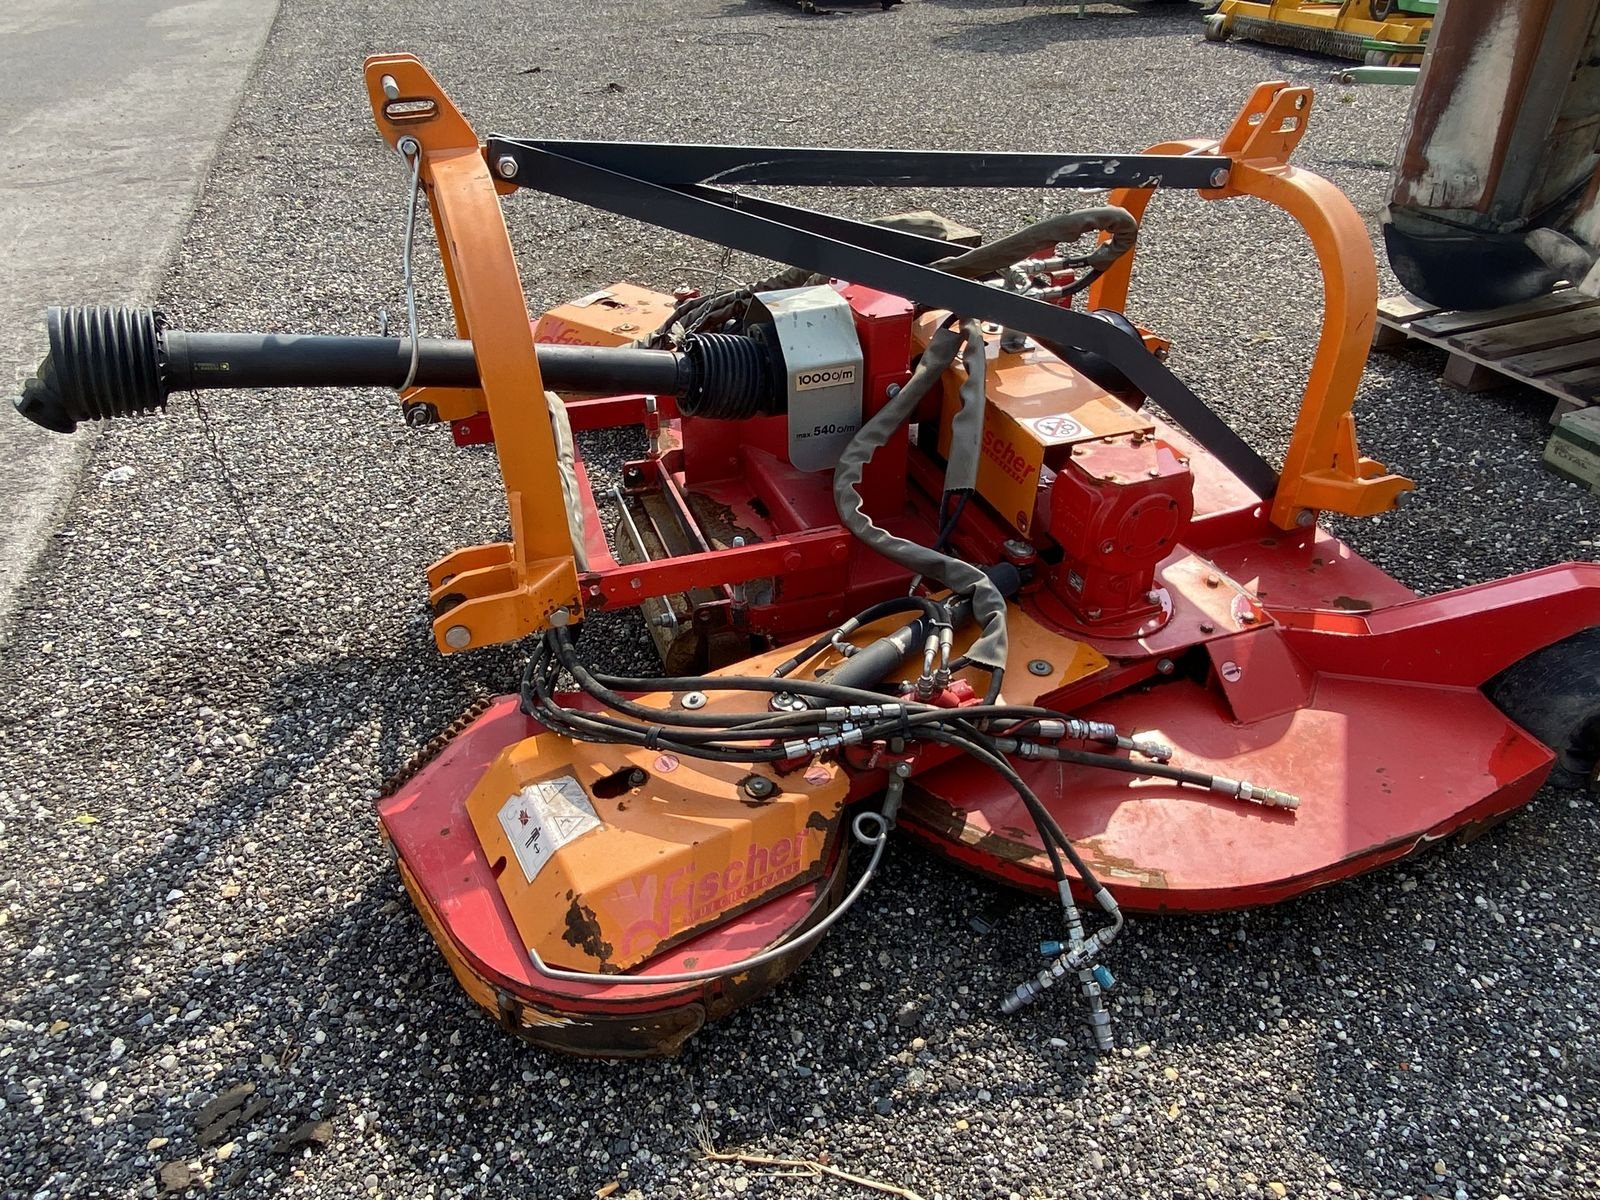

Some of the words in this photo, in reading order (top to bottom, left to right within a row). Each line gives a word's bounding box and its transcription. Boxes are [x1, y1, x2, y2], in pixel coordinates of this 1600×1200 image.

[813, 424, 836, 436] 540
[982, 430, 1035, 478] scher
[660, 828, 809, 936] Fischer
